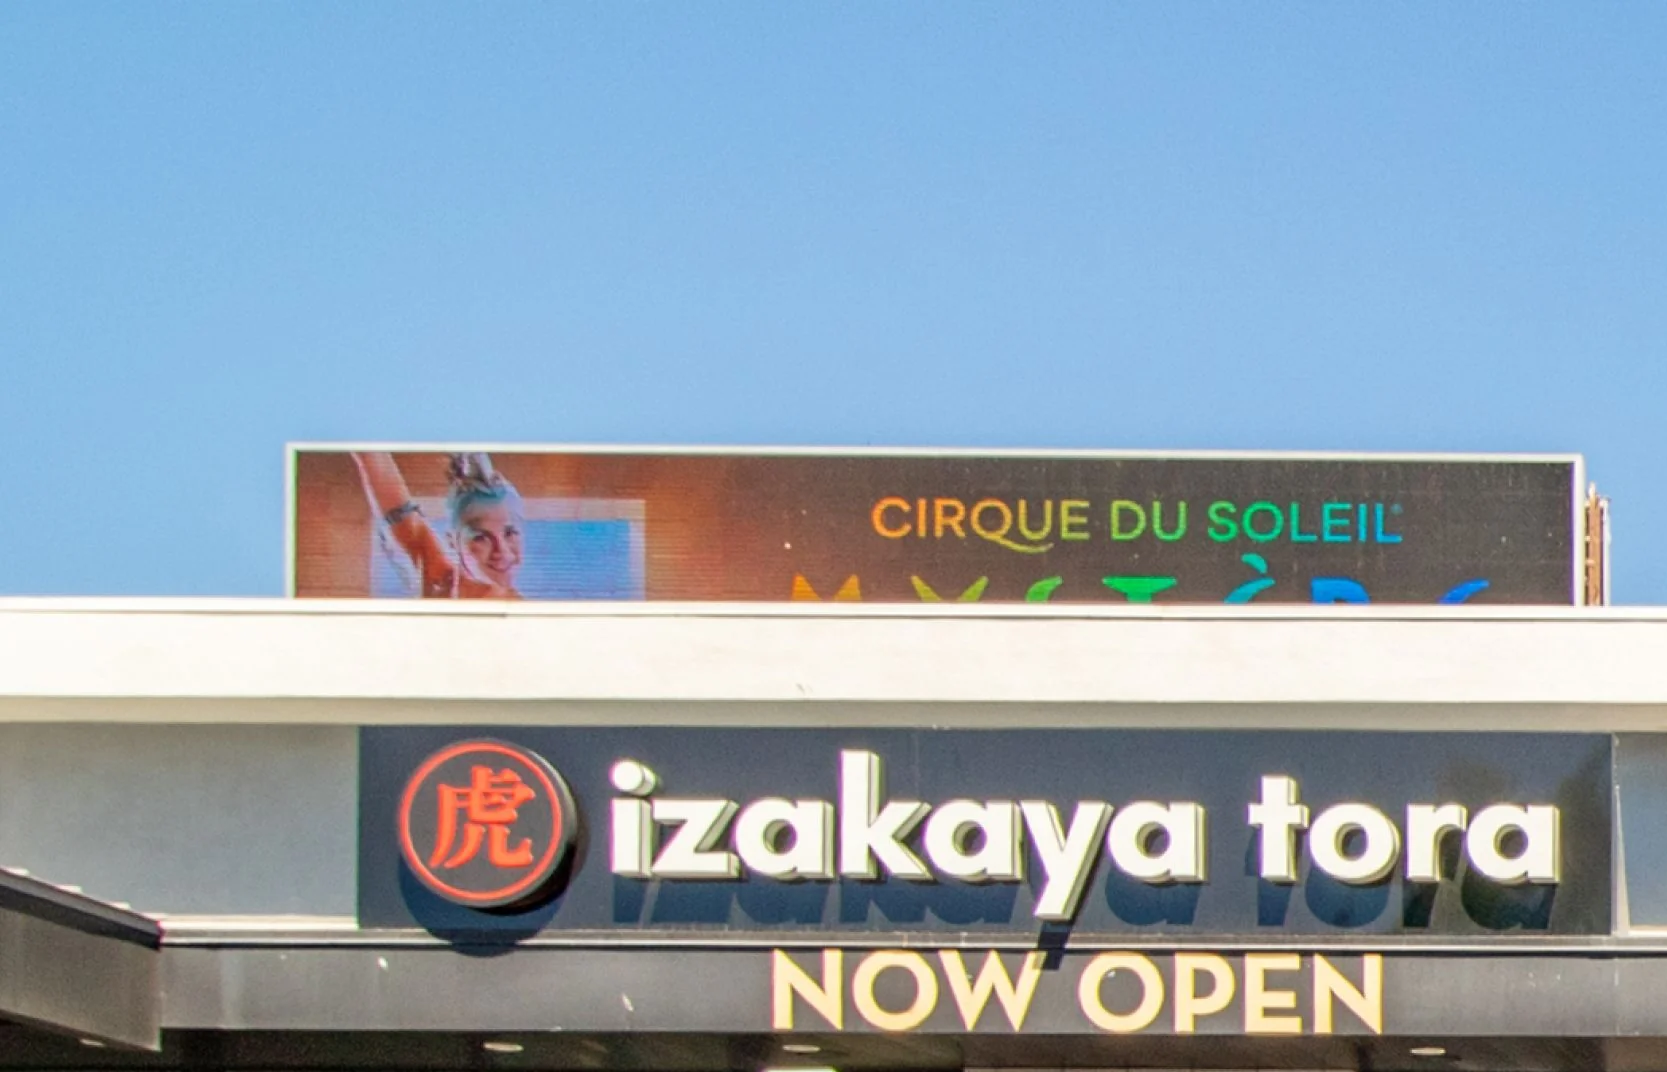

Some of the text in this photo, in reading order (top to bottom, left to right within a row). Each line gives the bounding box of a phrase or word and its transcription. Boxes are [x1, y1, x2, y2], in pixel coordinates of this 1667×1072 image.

[872, 499, 1403, 553] CIRQUE DU SOLEIL
[428, 765, 536, 870] 虎
[611, 749, 1561, 920] izakaya tora
[771, 949, 1384, 1034] NOW OPEN
